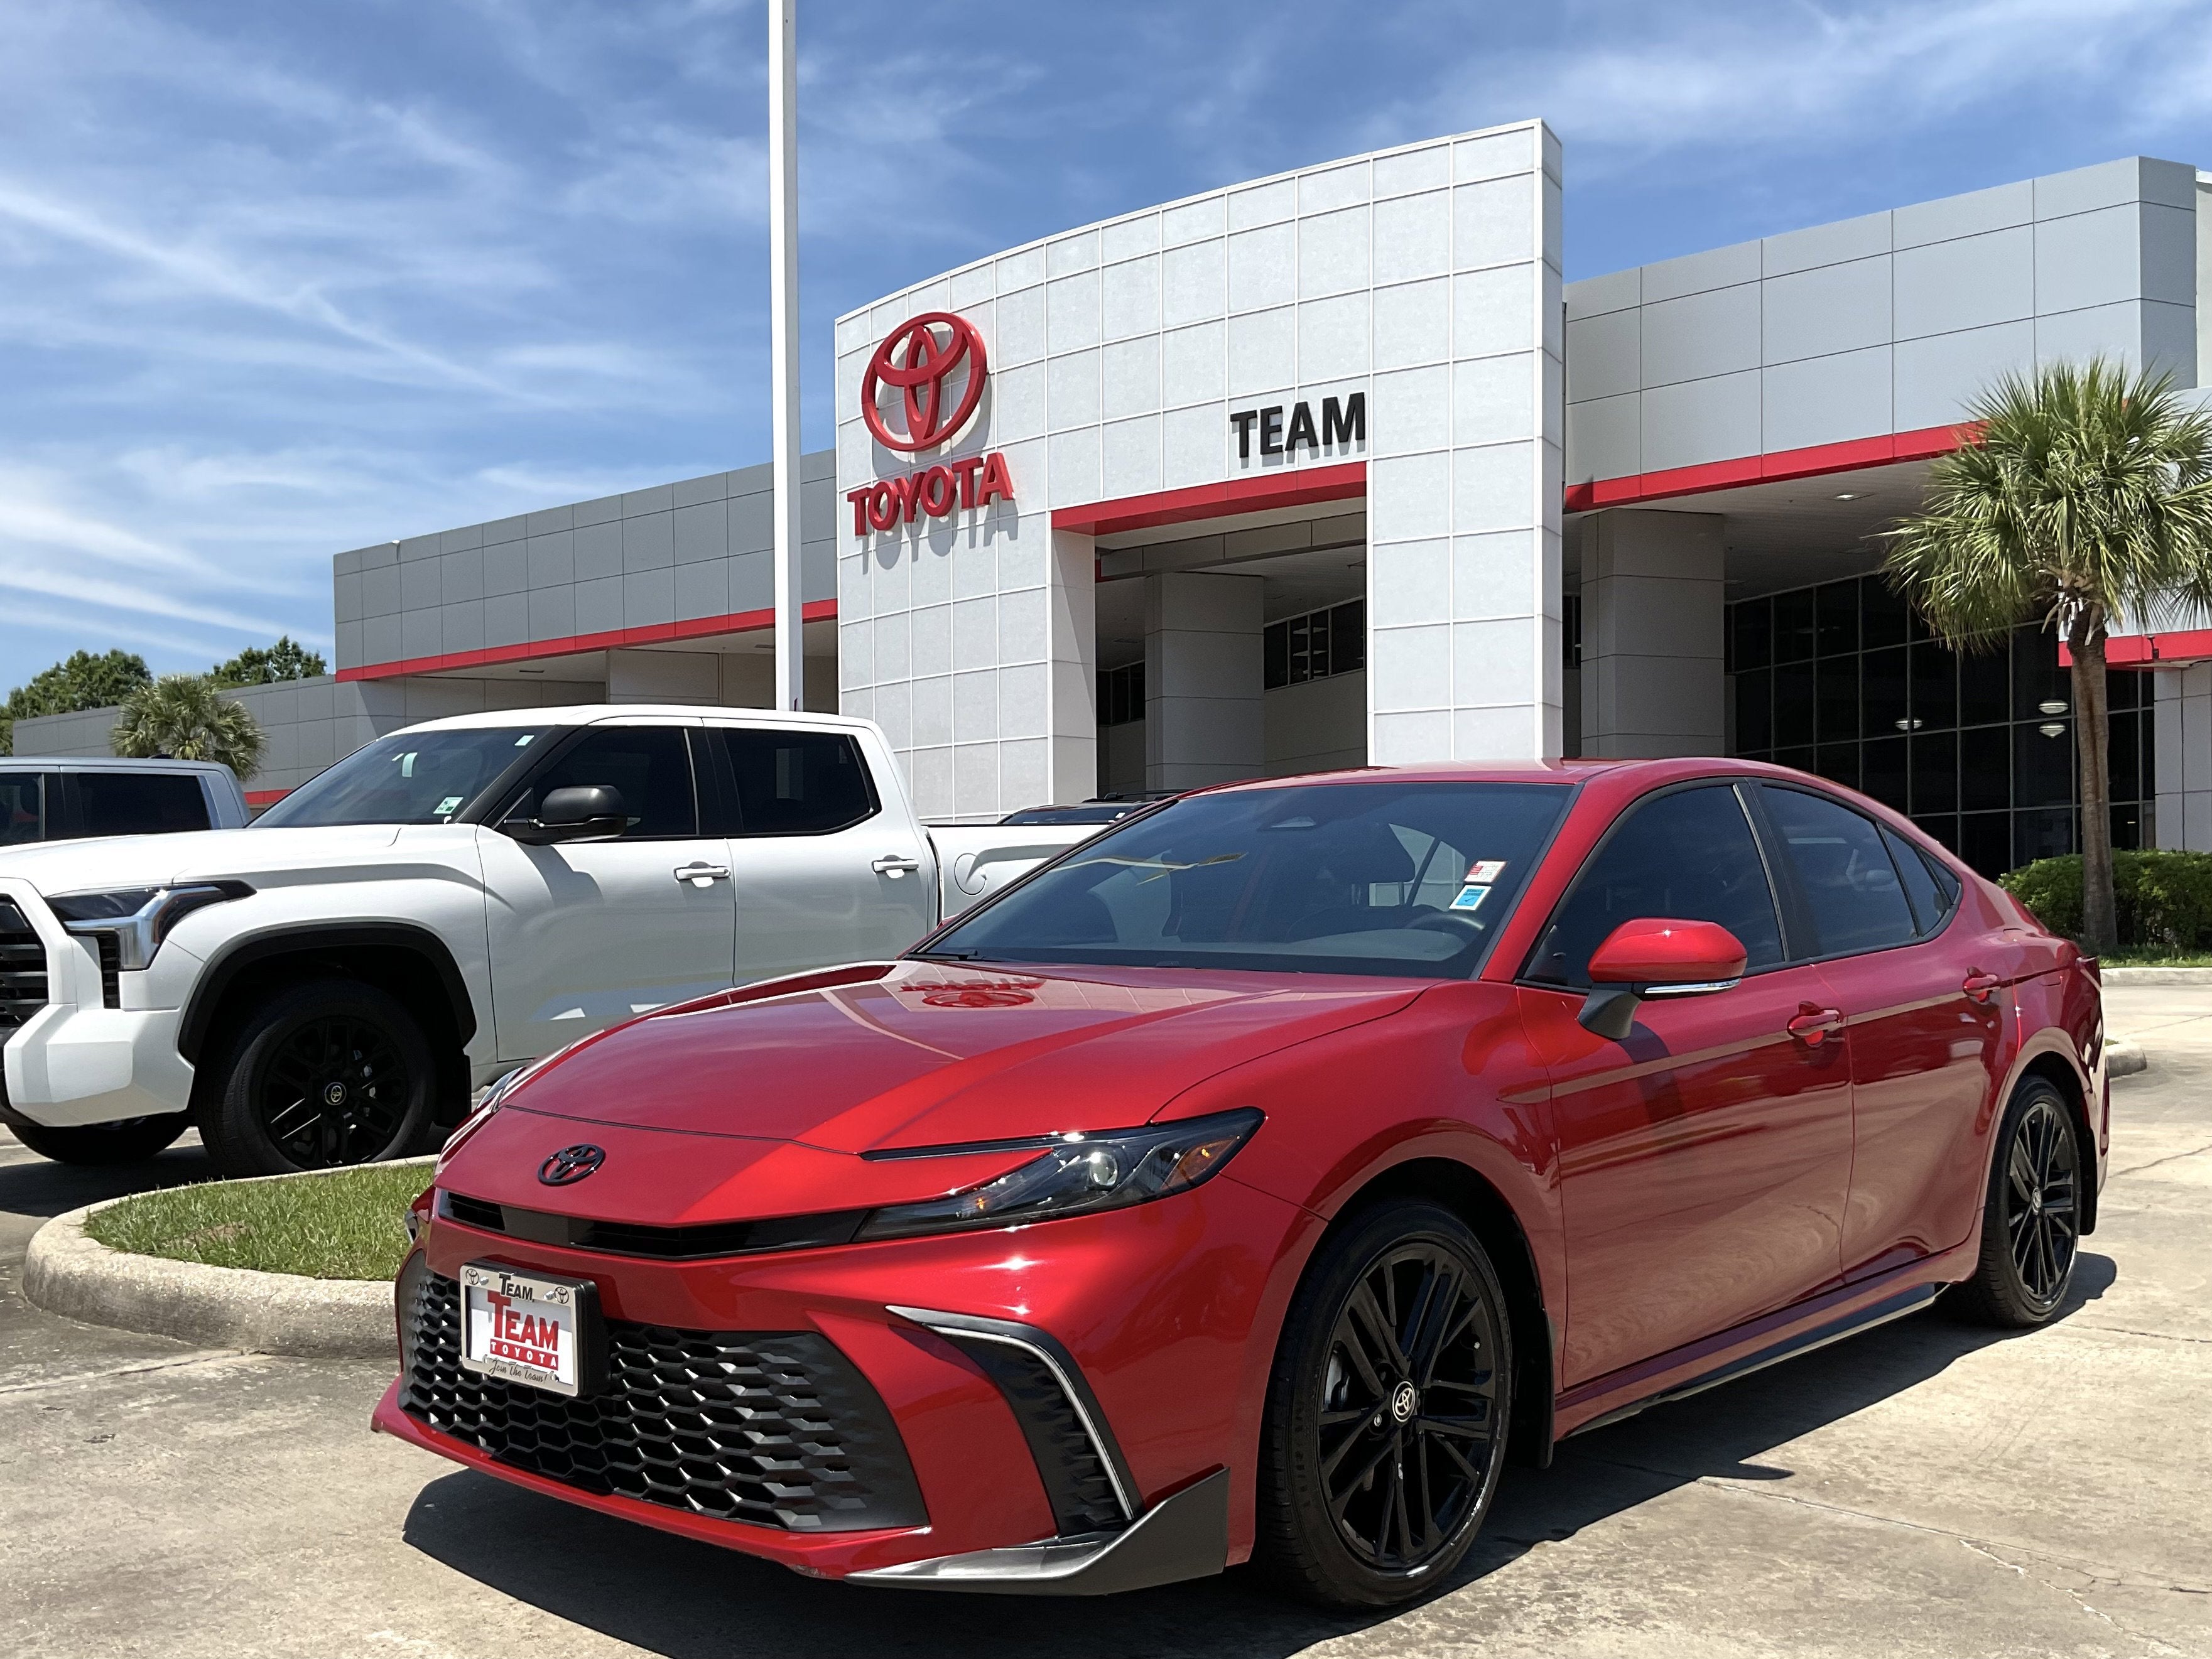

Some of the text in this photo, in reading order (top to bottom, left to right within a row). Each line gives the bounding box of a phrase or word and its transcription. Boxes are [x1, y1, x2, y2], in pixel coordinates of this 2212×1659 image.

[1230, 392, 1365, 458] TEAM
[847, 452, 1014, 536] TOYOTA
[489, 1358, 507, 1375] Join
[491, 1341, 557, 1368] TOYOTA
